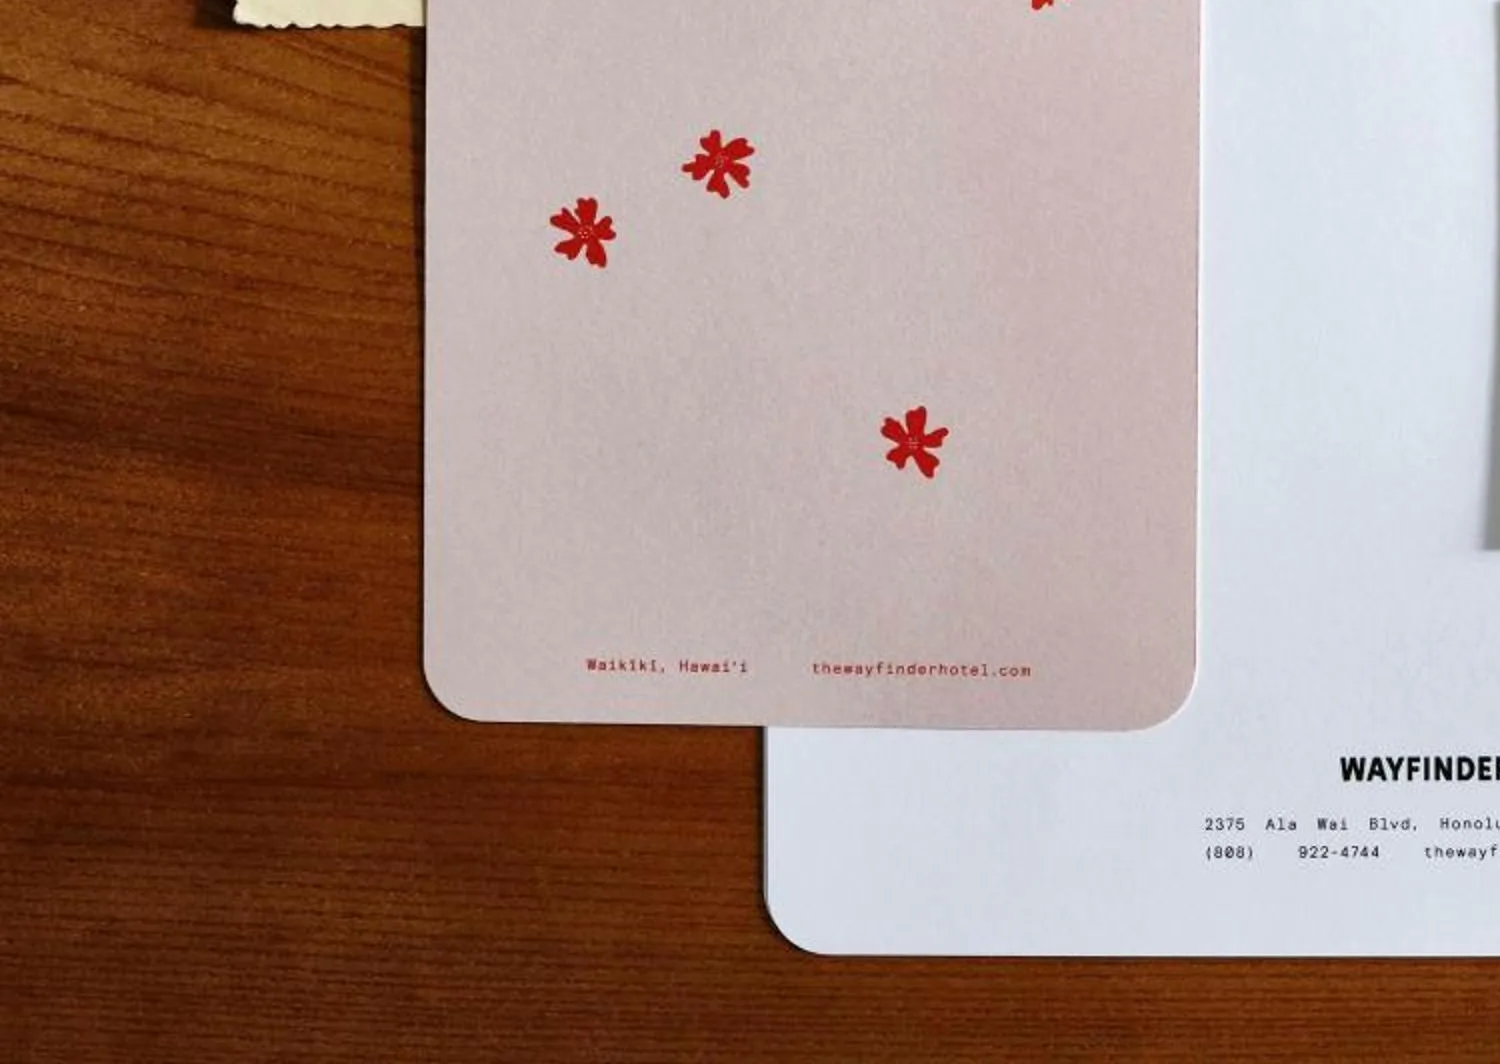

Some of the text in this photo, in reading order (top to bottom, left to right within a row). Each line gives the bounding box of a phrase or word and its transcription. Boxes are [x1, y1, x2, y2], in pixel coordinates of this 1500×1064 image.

[812, 661, 1032, 678] thewayfinderhotel.com
[1204, 817, 1246, 832] 2375
[1265, 817, 1297, 831] Ala
[1317, 817, 1348, 831] Wai
[1369, 817, 1418, 832] Blvd,
[1205, 845, 1253, 861] (808)
[1298, 845, 1380, 860] 922-4744
